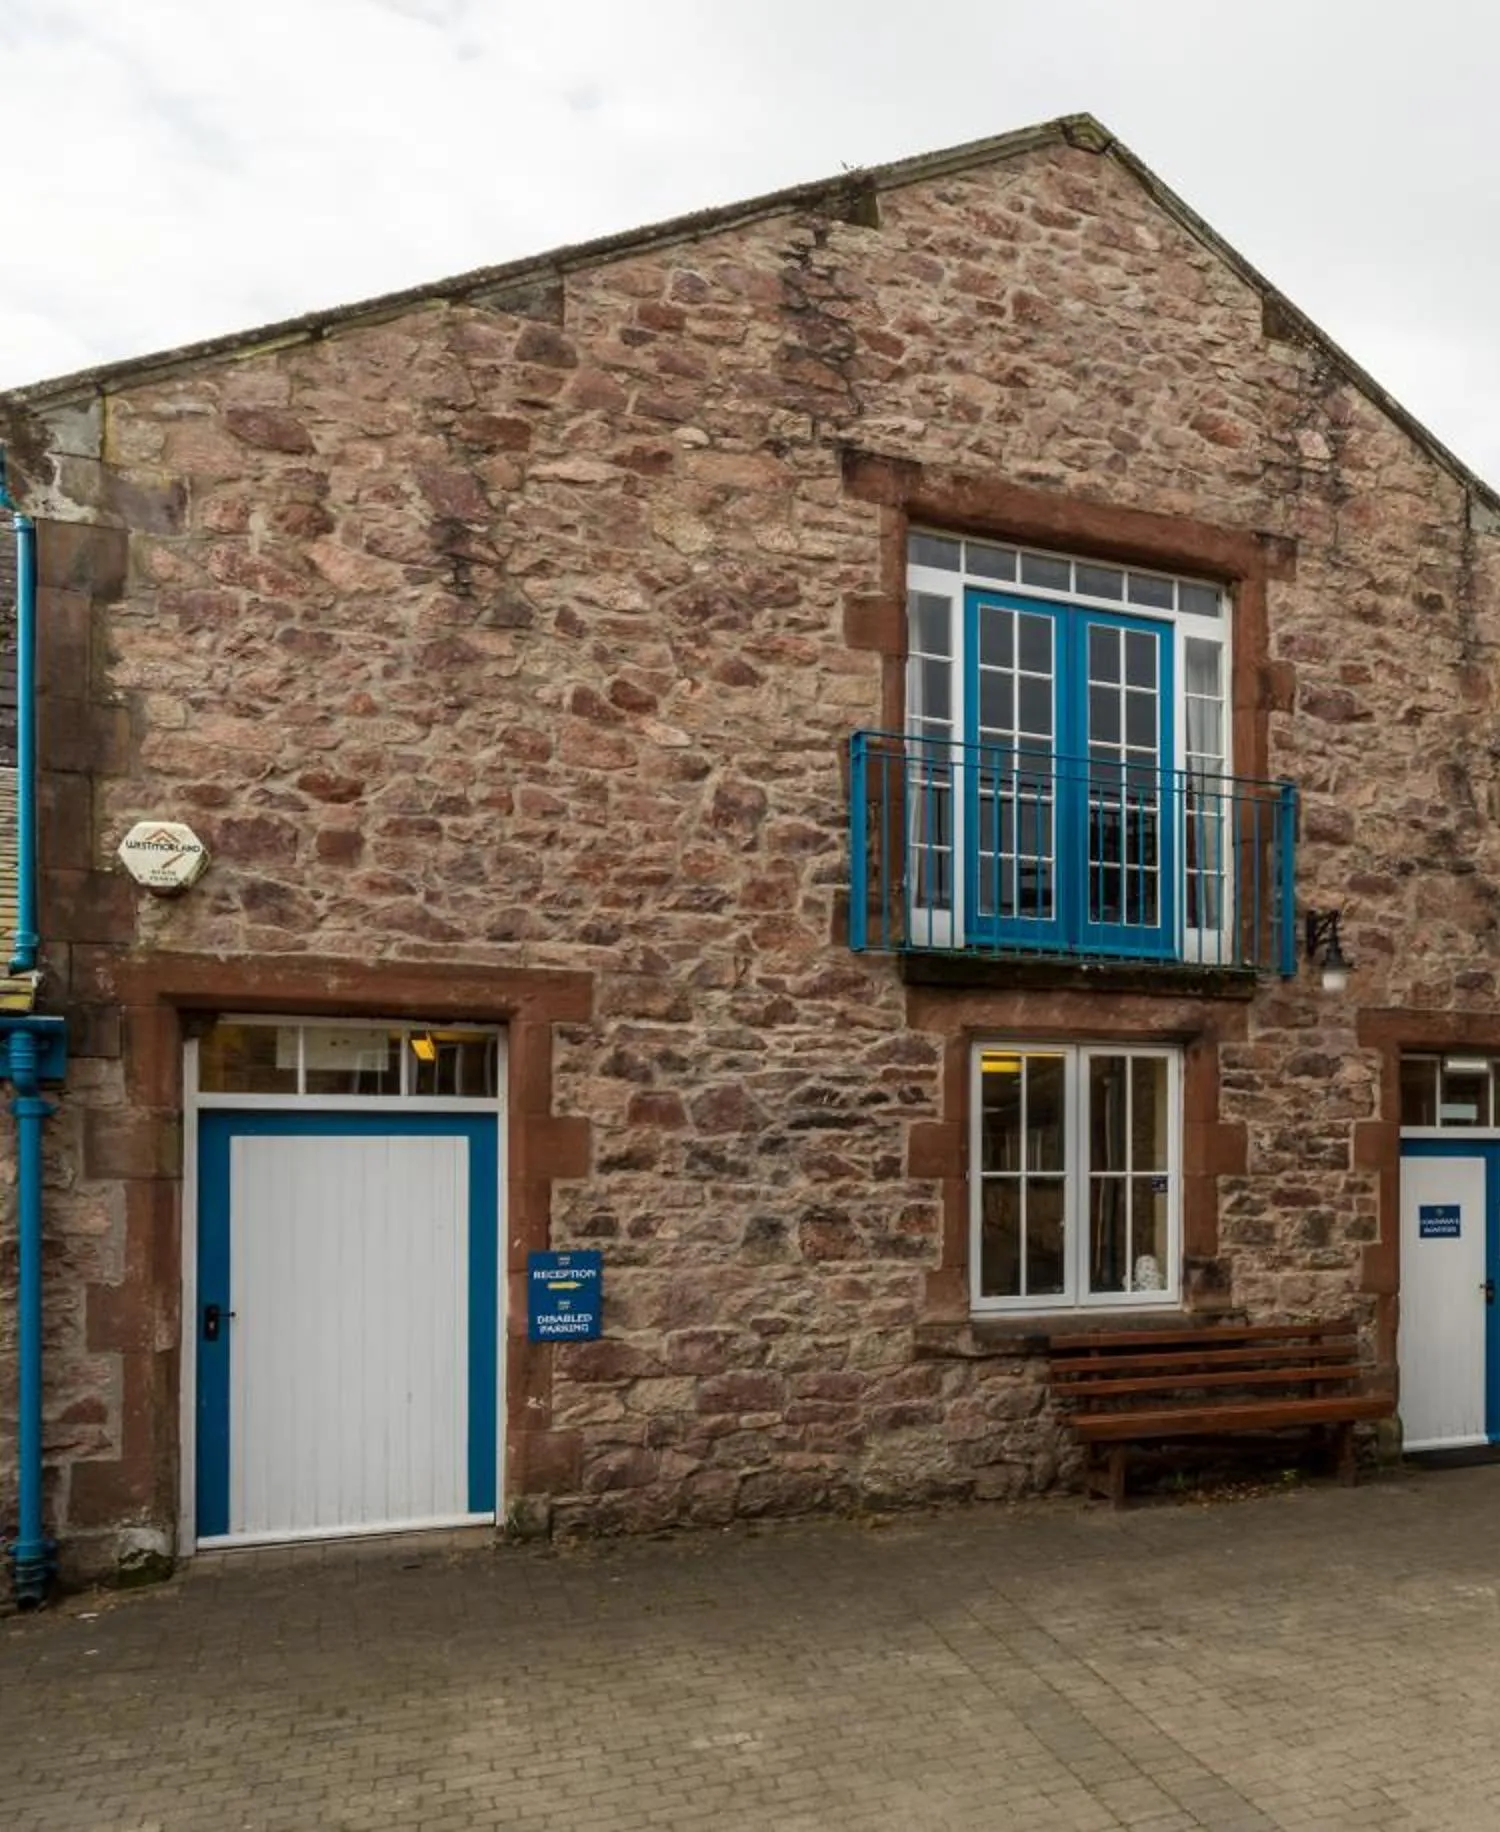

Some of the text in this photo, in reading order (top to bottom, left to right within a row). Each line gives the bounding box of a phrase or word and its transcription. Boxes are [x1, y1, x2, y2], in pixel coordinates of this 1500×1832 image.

[126, 840, 201, 852] WESTMORLAND
[533, 1269, 597, 1280] RECEPTION
[537, 1313, 593, 1325] DISABLED
[540, 1323, 589, 1335] PARKING
